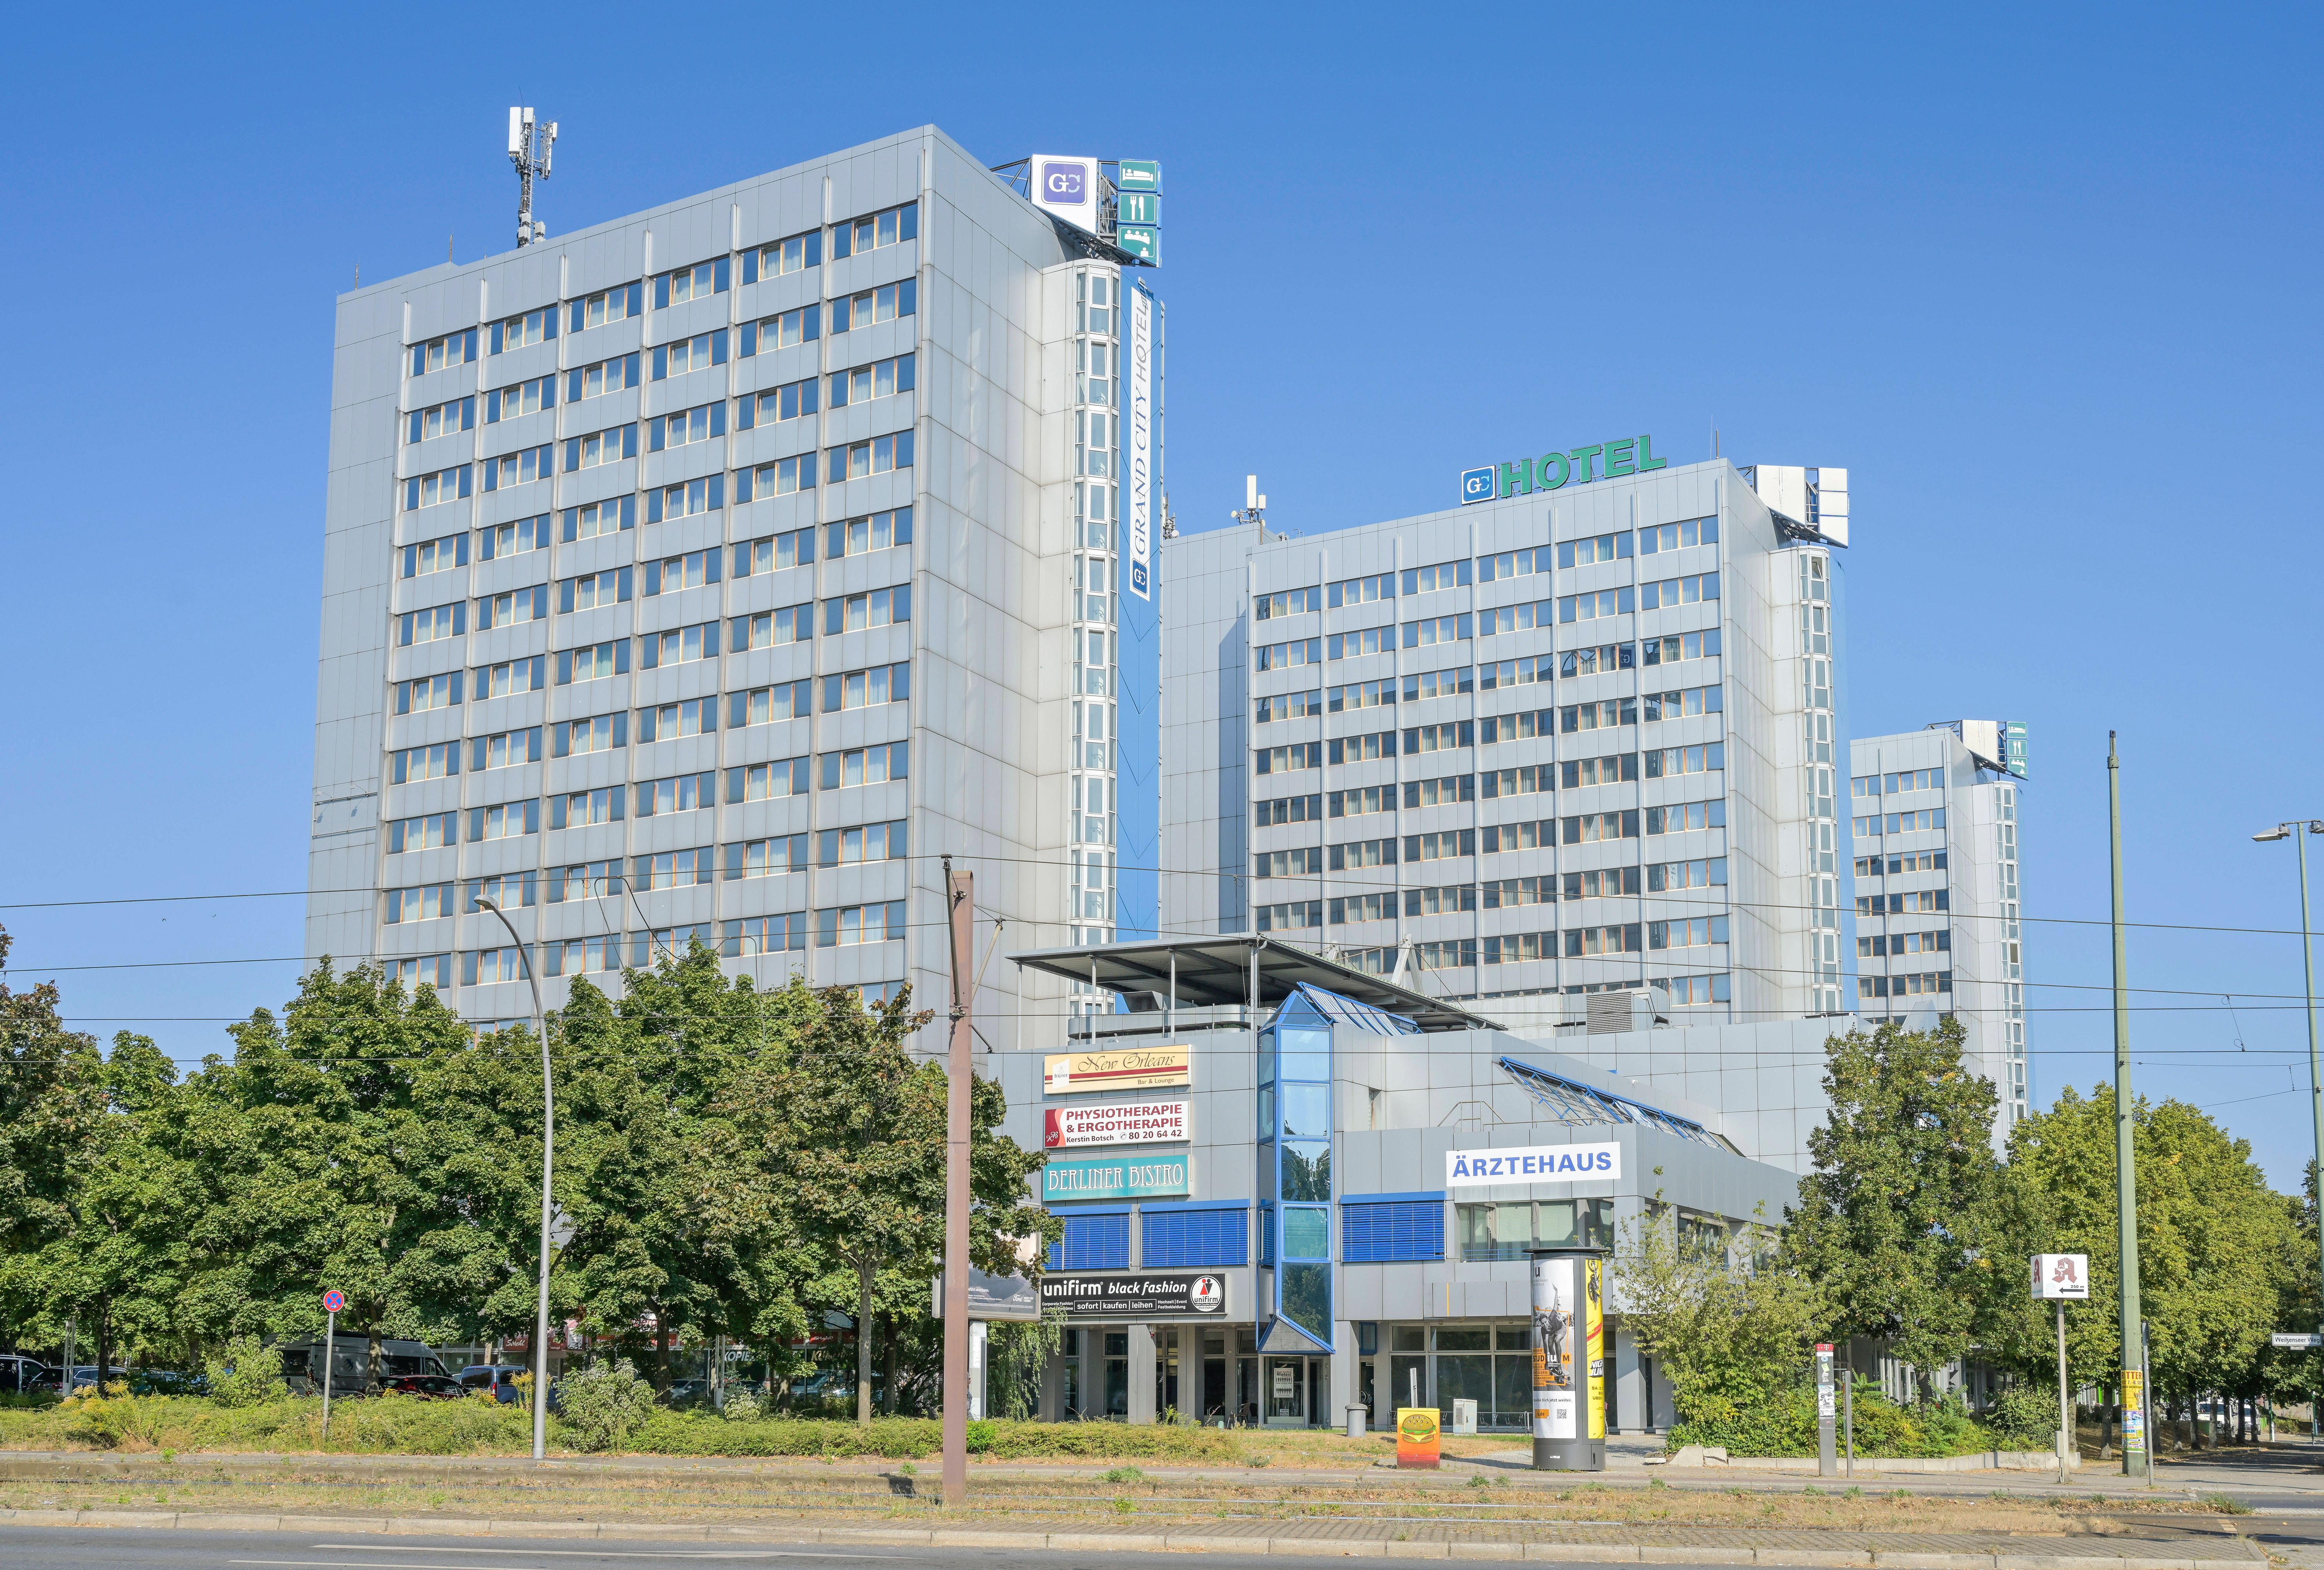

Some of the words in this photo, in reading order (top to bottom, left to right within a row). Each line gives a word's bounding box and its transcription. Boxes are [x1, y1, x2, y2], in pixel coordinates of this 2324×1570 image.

[1136, 306, 1147, 382] HOTEL
[1136, 384, 1146, 451] CITY
[1500, 434, 1666, 499] HOTEL
[1135, 458, 1146, 555] GRAND
[1078, 1055, 1118, 1072] New
[1123, 1053, 1176, 1069] Orleans
[1067, 1104, 1182, 1120] PHYSIOTHERAPIE
[1066, 1124, 1074, 1133] &
[1078, 1117, 1182, 1132] ERGOTHERAPIE
[1129, 1132, 1140, 1140] 80
[1143, 1131, 1154, 1139] 20
[1452, 1152, 1612, 1177] ÄRZTEHAUS
[1048, 1167, 1123, 1190] BERLINER
[1129, 1163, 1183, 1187] BISTRO
[1013, 1294, 1022, 1302] Ford
[1108, 1281, 1141, 1294] black
[1141, 1281, 1187, 1296] fashion
[2121, 1371, 2142, 1379] RITTER
